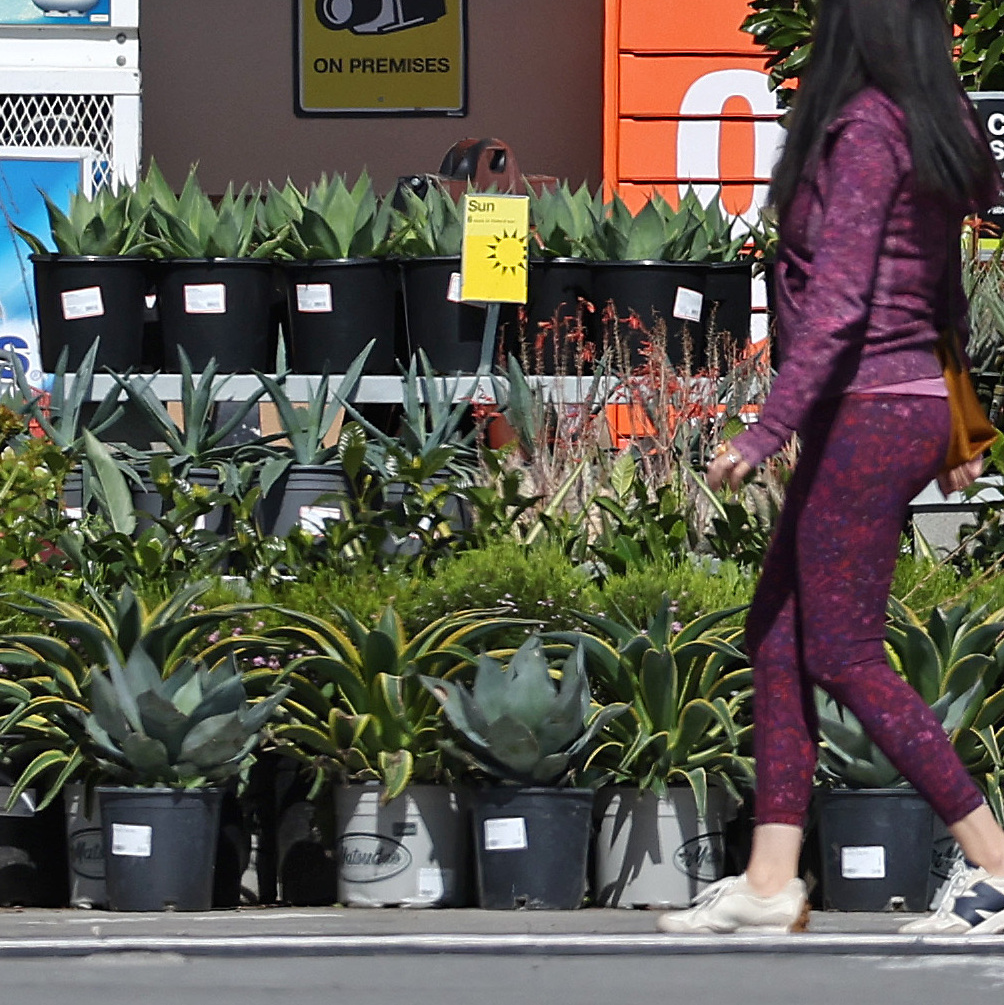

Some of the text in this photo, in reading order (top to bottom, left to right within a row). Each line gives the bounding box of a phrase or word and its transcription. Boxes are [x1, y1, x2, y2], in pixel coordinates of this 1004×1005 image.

[313, 57, 451, 74] ON PREMISES
[468, 199, 495, 212] Sun
